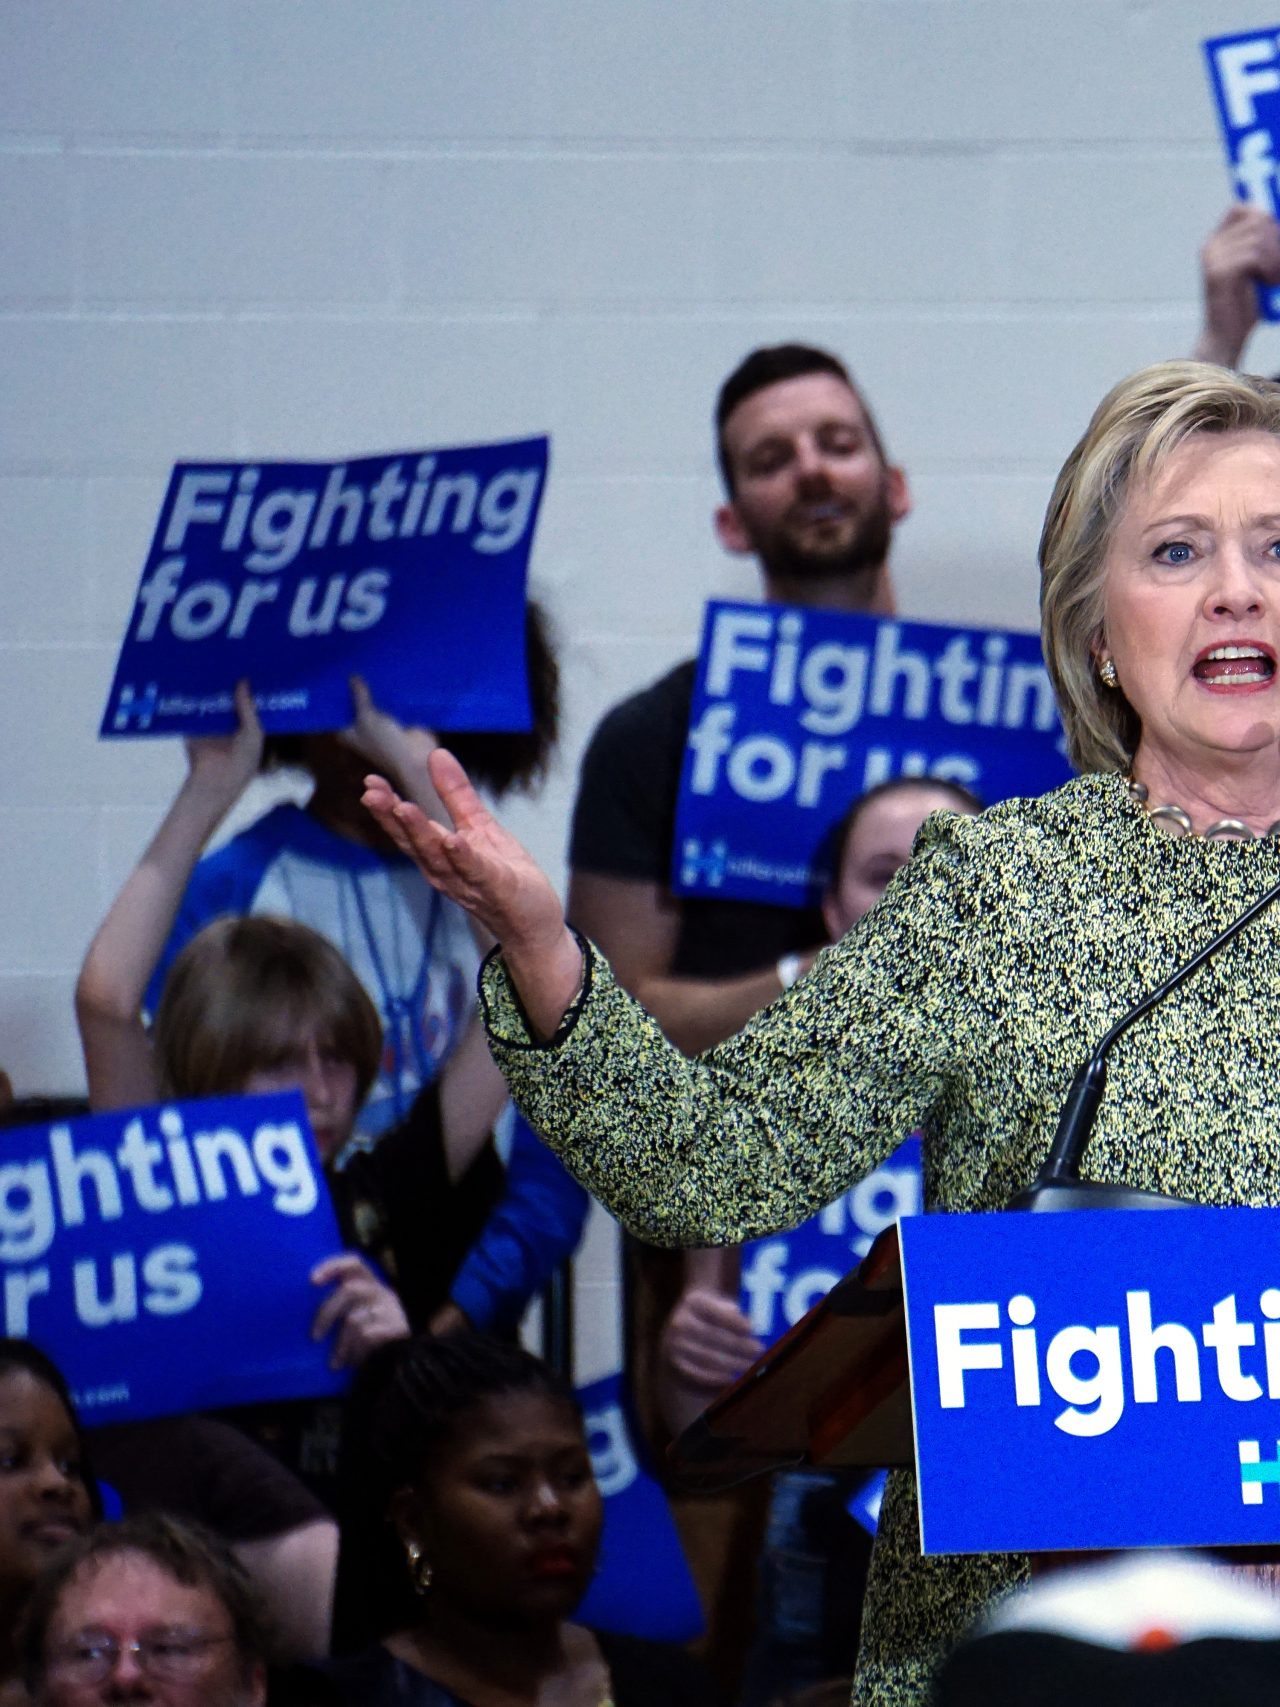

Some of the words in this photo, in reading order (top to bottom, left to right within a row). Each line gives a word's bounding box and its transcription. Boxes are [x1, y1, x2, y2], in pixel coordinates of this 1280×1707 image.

[162, 454, 540, 573] Fighting
[135, 556, 278, 642] for
[287, 569, 392, 637] us
[706, 607, 1060, 736] Fightin
[689, 703, 848, 808] for
[0, 1107, 319, 1262] ghting
[74, 1243, 203, 1327] us
